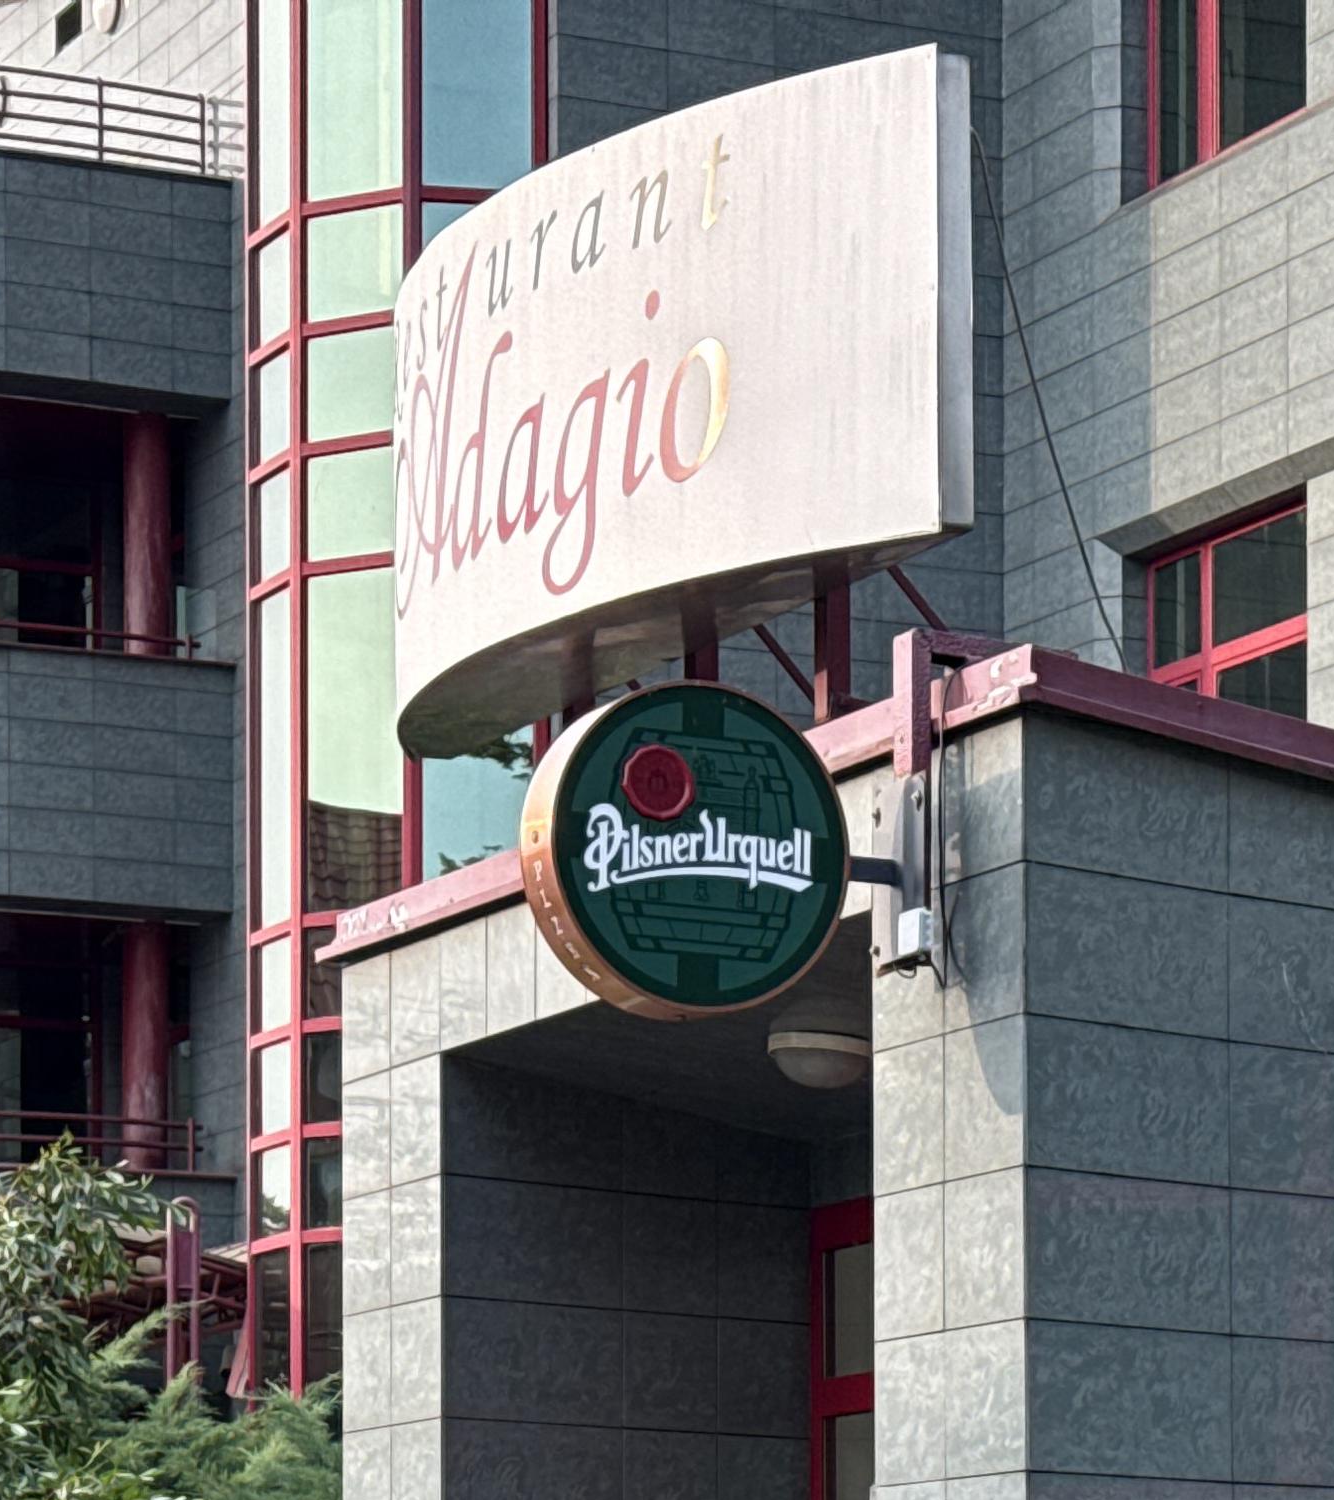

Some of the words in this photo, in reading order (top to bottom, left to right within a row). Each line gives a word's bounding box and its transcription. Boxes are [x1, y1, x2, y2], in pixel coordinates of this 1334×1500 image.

[395, 240, 732, 621] Adagio
[583, 803, 698, 892] Pilsner
[699, 809, 813, 890] Urquell
